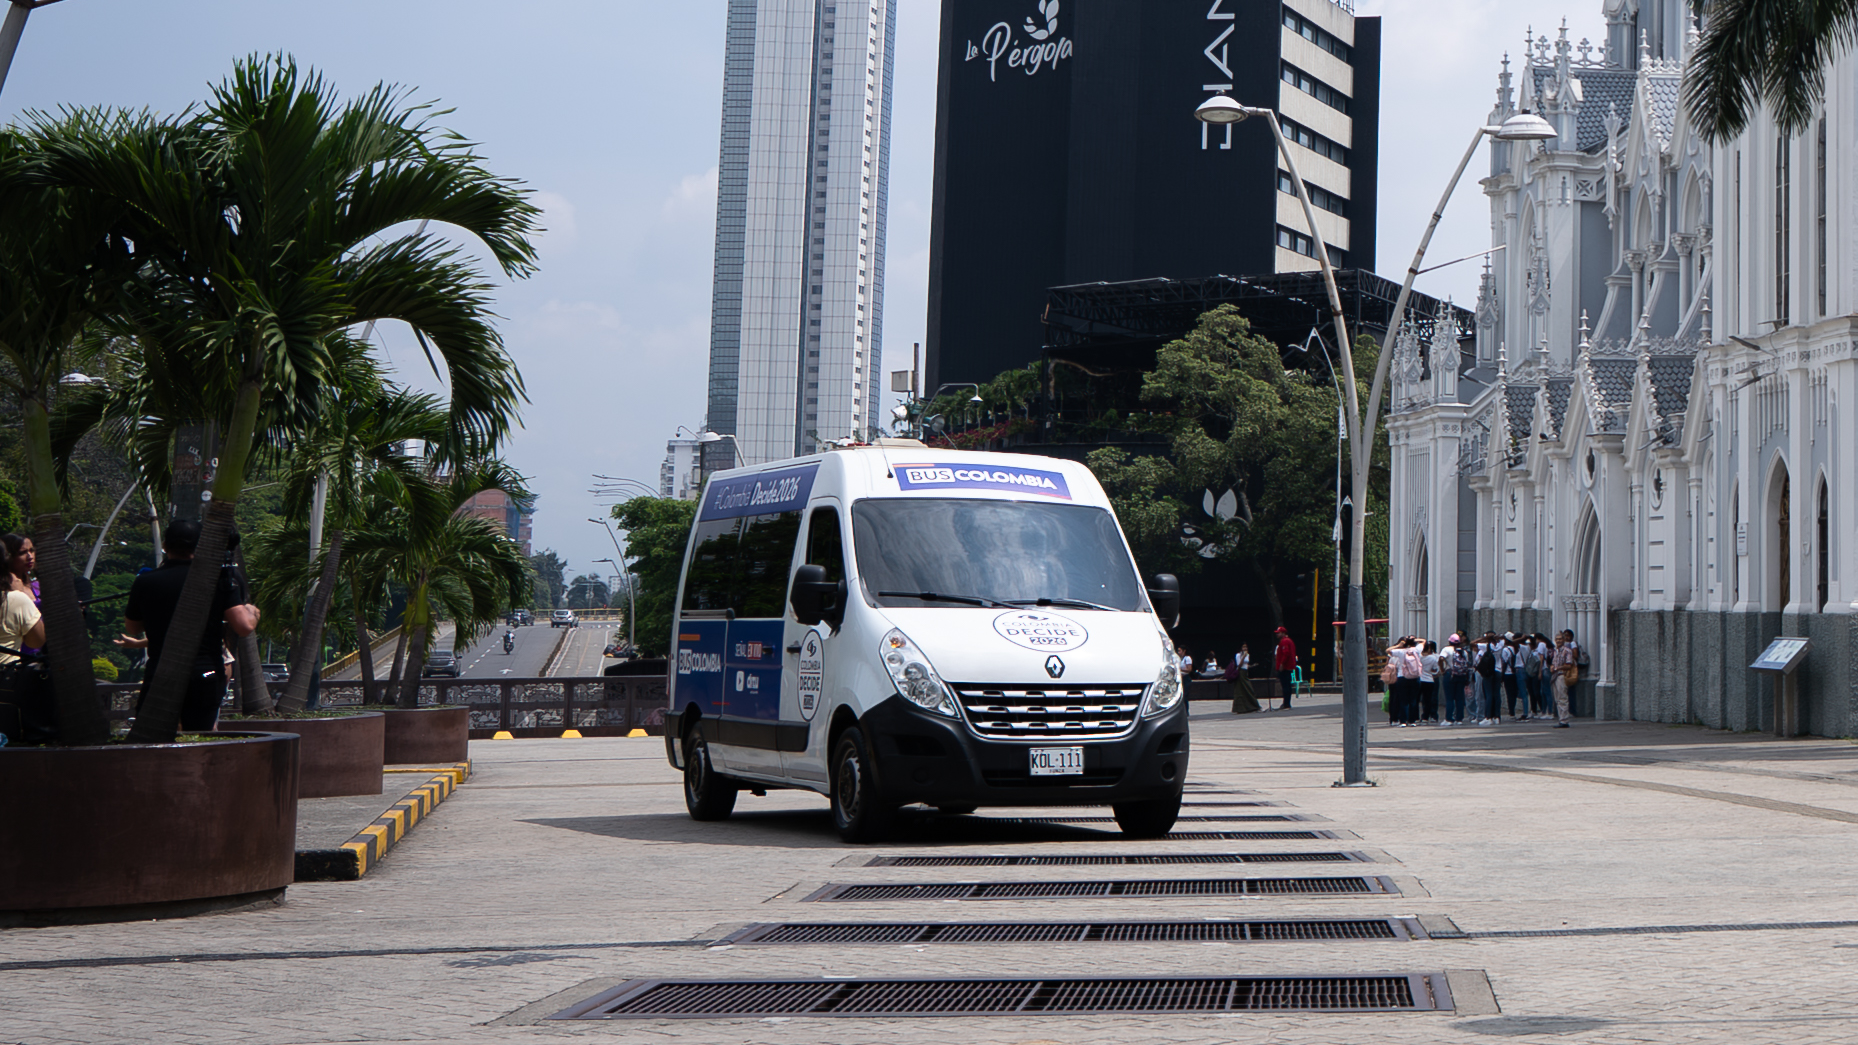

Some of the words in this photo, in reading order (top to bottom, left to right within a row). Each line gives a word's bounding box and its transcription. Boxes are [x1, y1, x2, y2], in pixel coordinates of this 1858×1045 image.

[964, 39, 979, 61] La
[982, 21, 1073, 82] Pérgola
[911, 470, 951, 481] BUS
[954, 469, 1058, 490] COLOMBIA
[1006, 628, 1080, 637] DECIDE
[1030, 637, 1067, 645] 2026
[680, 652, 691, 671] BUS
[692, 652, 722, 672] COLOMBIA
[799, 676, 820, 691] DECIDE
